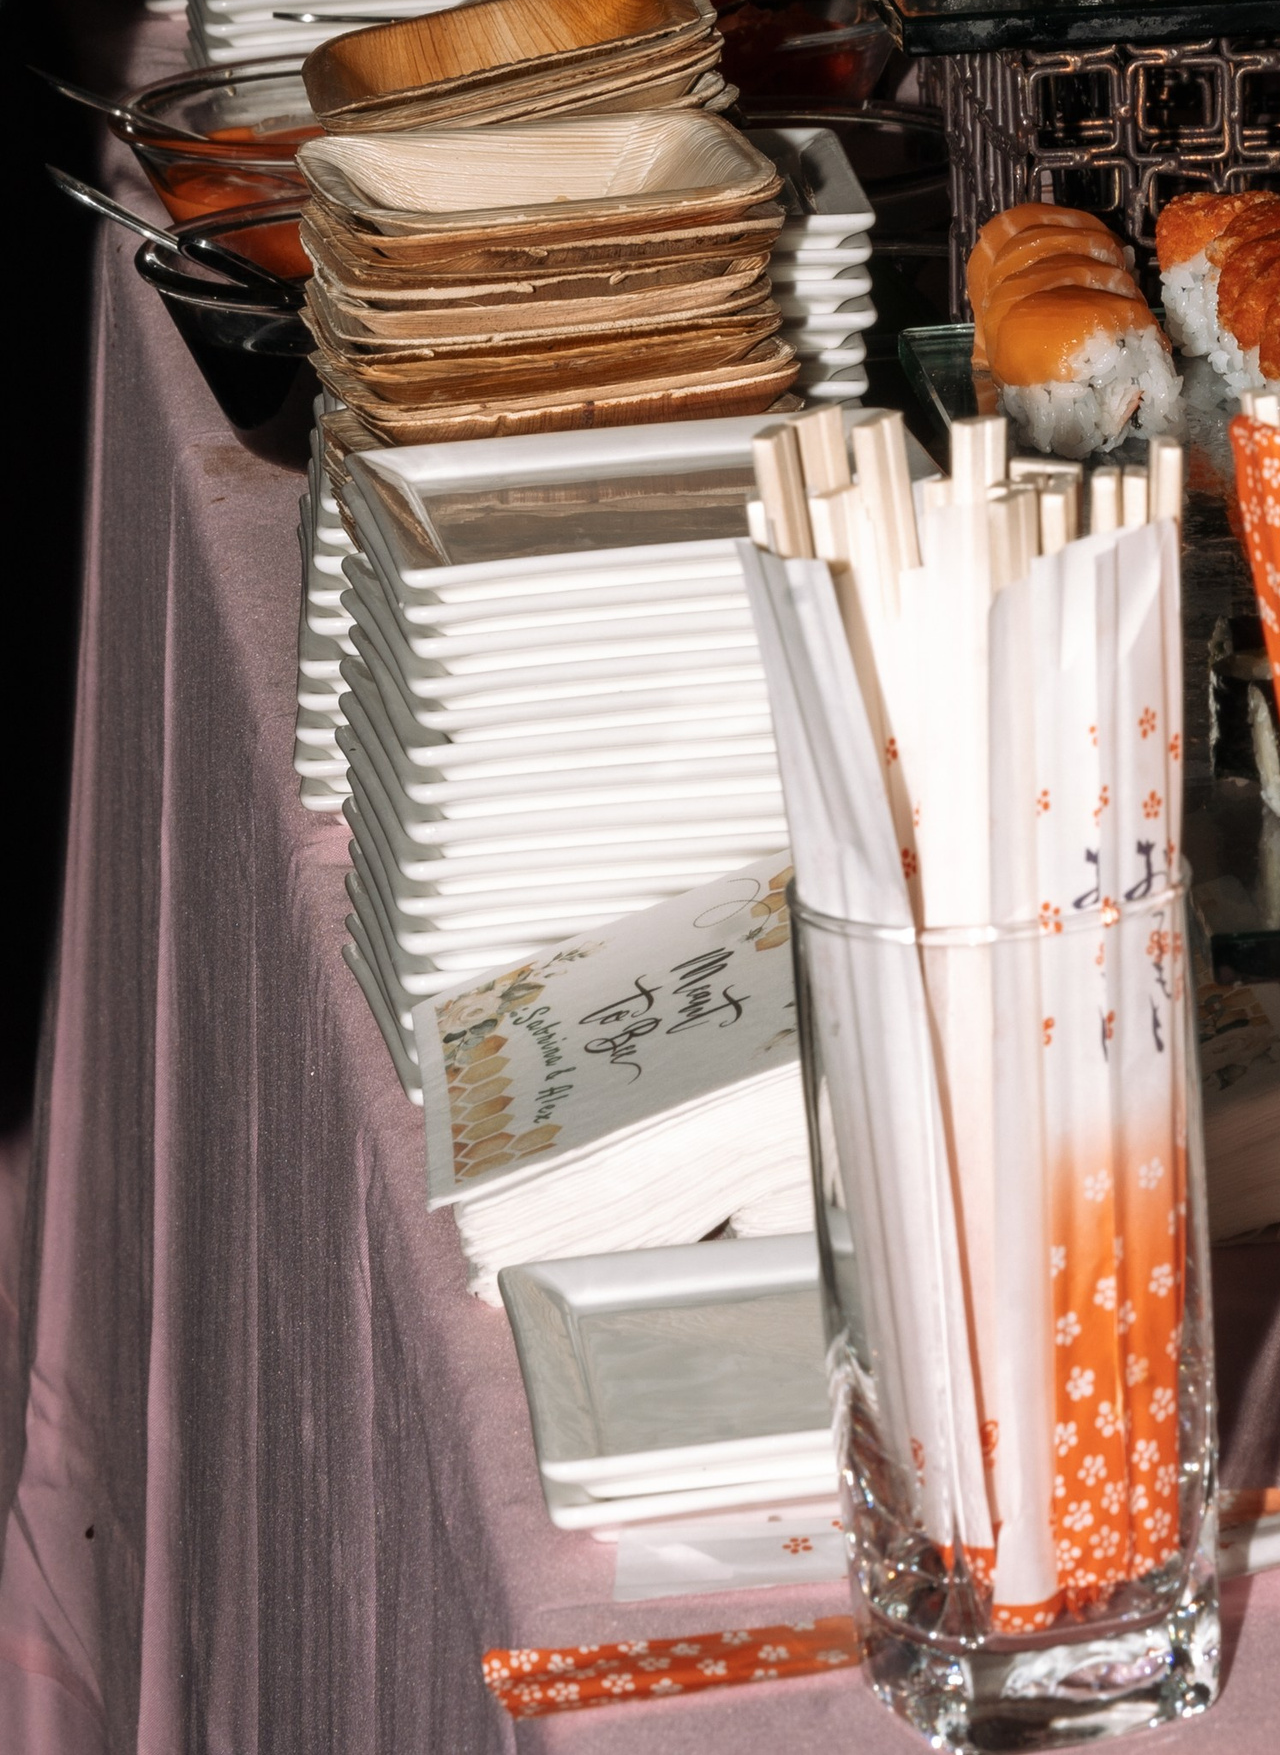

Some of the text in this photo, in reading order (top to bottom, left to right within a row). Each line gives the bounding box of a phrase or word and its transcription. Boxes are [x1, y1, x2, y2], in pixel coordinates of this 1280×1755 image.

[666, 947, 752, 1035] Meant
[512, 1006, 577, 1124] Sabrina & Alex
[583, 1018, 662, 1086] Bee
